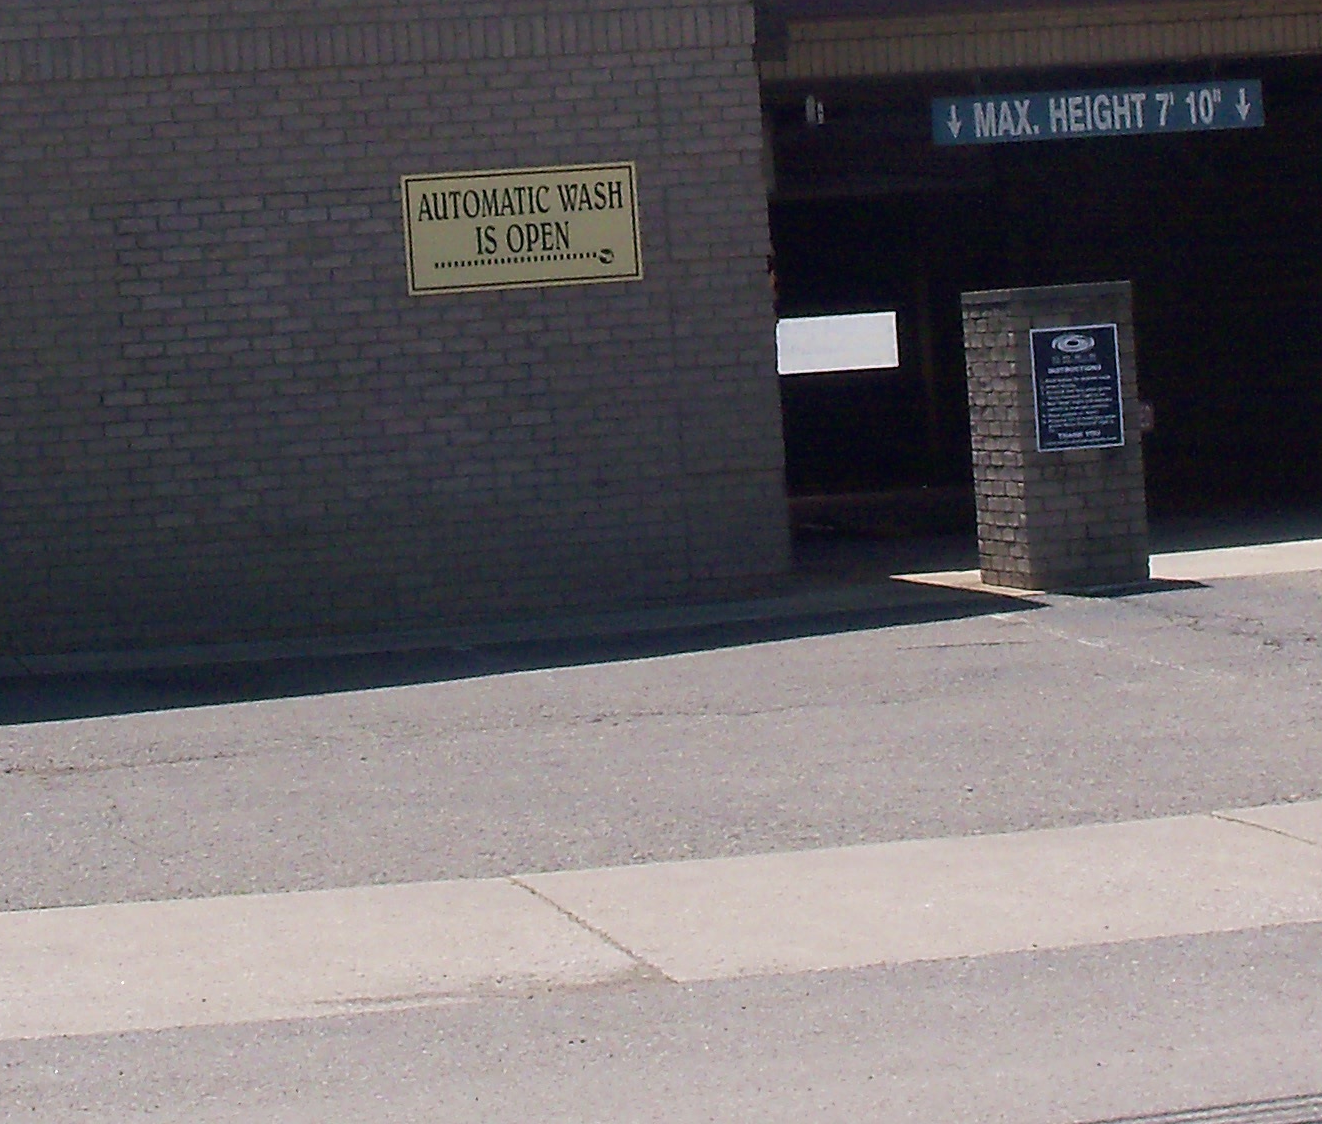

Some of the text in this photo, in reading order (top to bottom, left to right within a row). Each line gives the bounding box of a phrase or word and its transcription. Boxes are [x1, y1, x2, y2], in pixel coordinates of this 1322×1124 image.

[972, 87, 1222, 138] MAX. HEIGHT 7' 10"
[417, 180, 624, 222] AUTOMATIC WASH
[475, 220, 571, 256] IS OPEN
